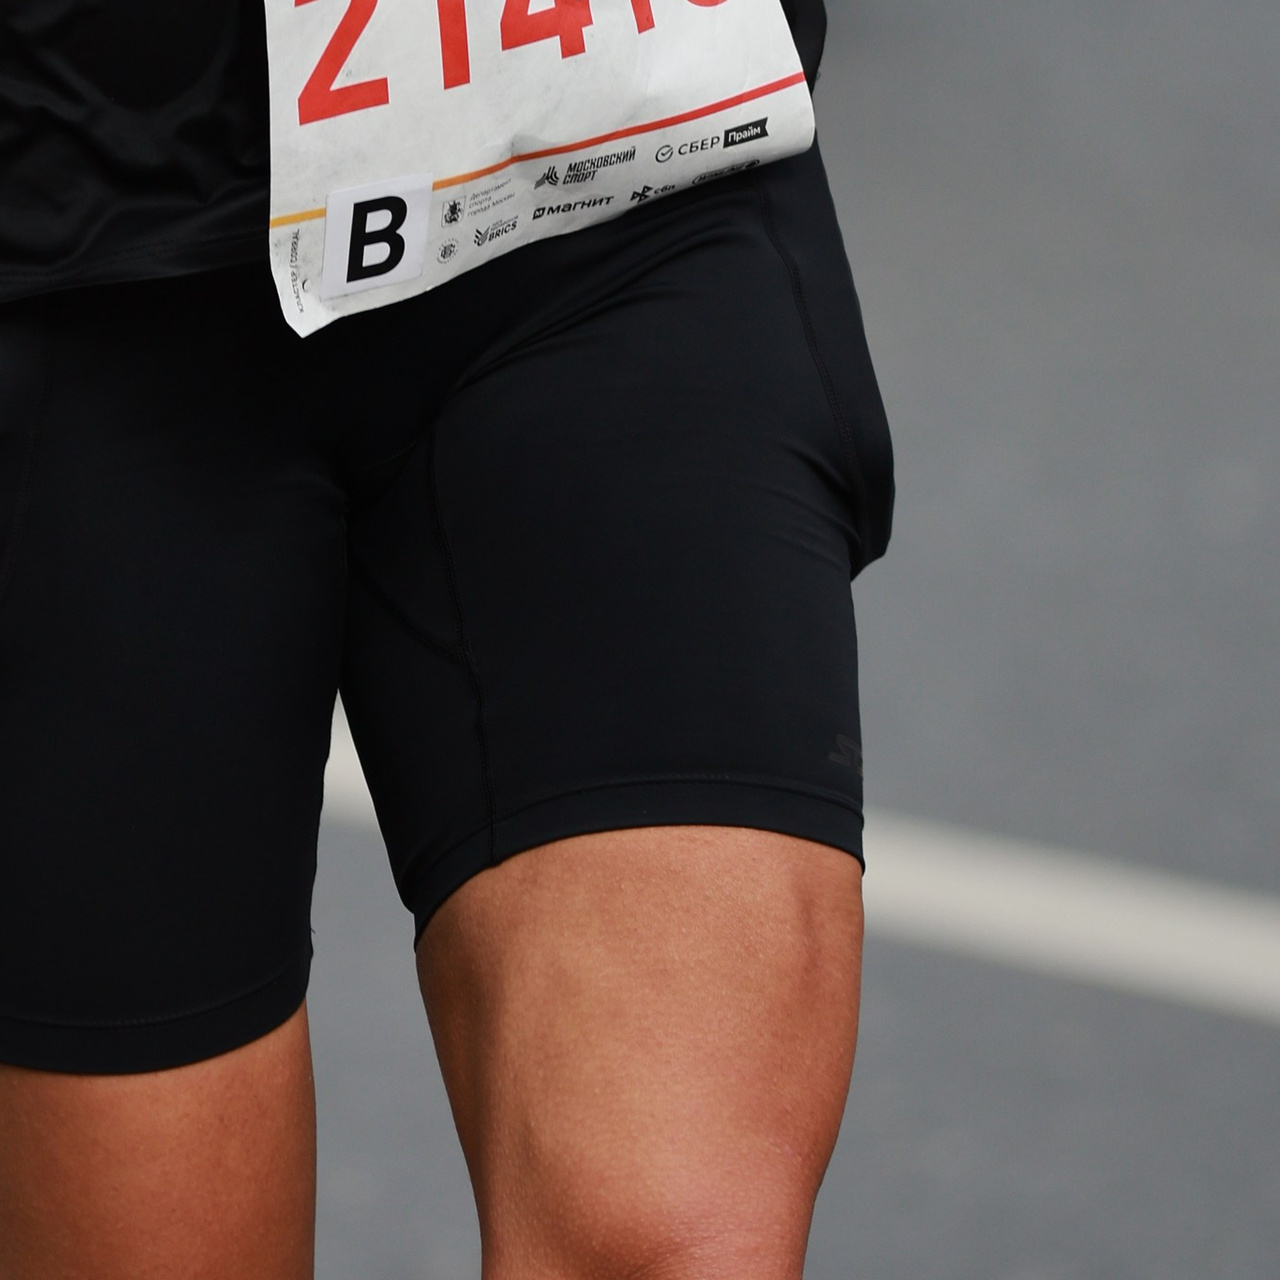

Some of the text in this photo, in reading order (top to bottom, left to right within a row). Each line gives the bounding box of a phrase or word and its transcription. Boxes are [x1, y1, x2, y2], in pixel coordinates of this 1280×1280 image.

[677, 126, 761, 156] СБЕР Прайм
[566, 146, 636, 174] МОСКОВСКИЙ
[562, 170, 598, 185] СПОРТ
[346, 196, 407, 283] B
[488, 220, 518, 241] BRICS
